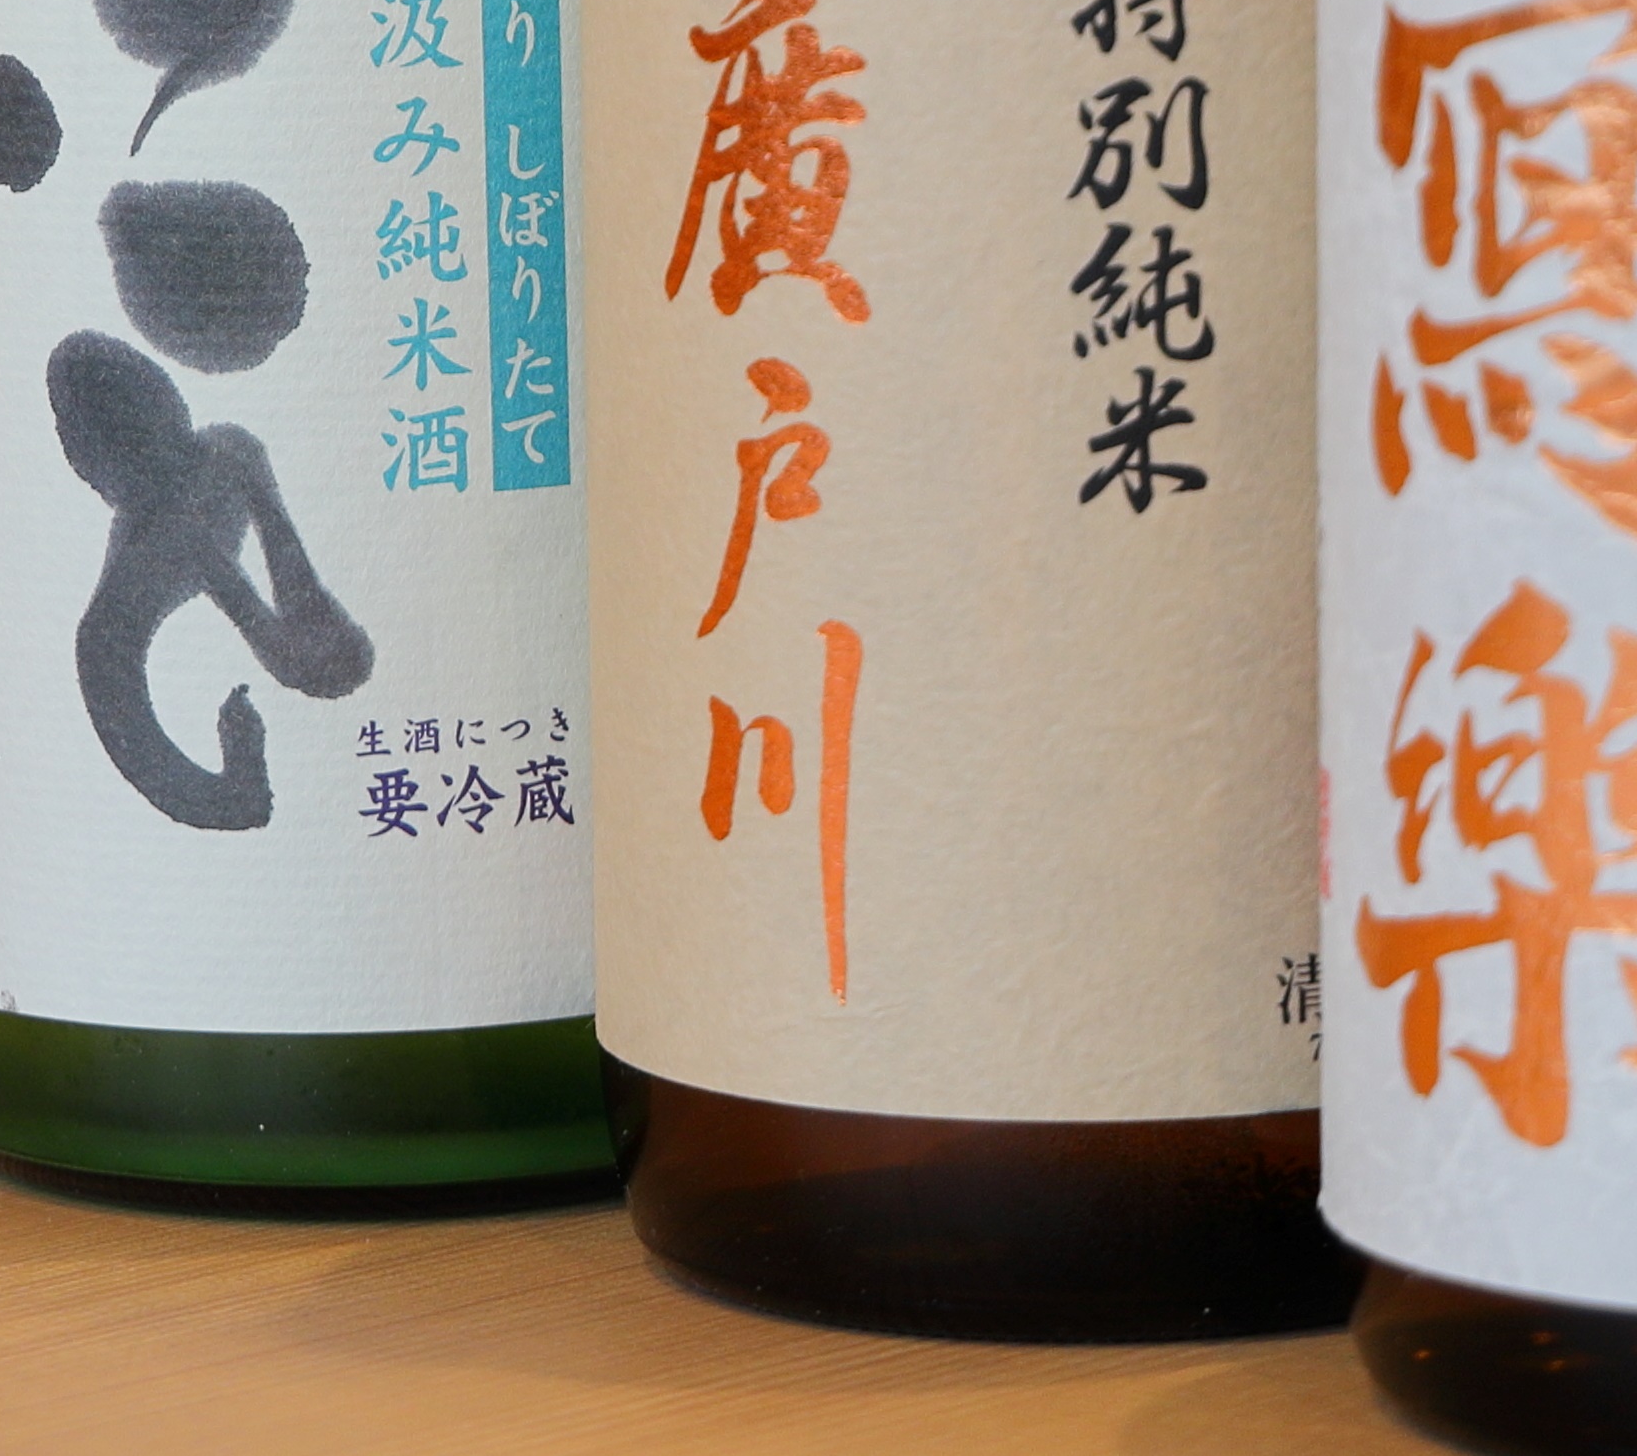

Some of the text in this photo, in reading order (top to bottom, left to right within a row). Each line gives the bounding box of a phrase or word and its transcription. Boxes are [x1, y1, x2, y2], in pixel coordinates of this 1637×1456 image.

[355, 707, 571, 758] 生酒につき
[359, 755, 575, 839] 要冷蔵
